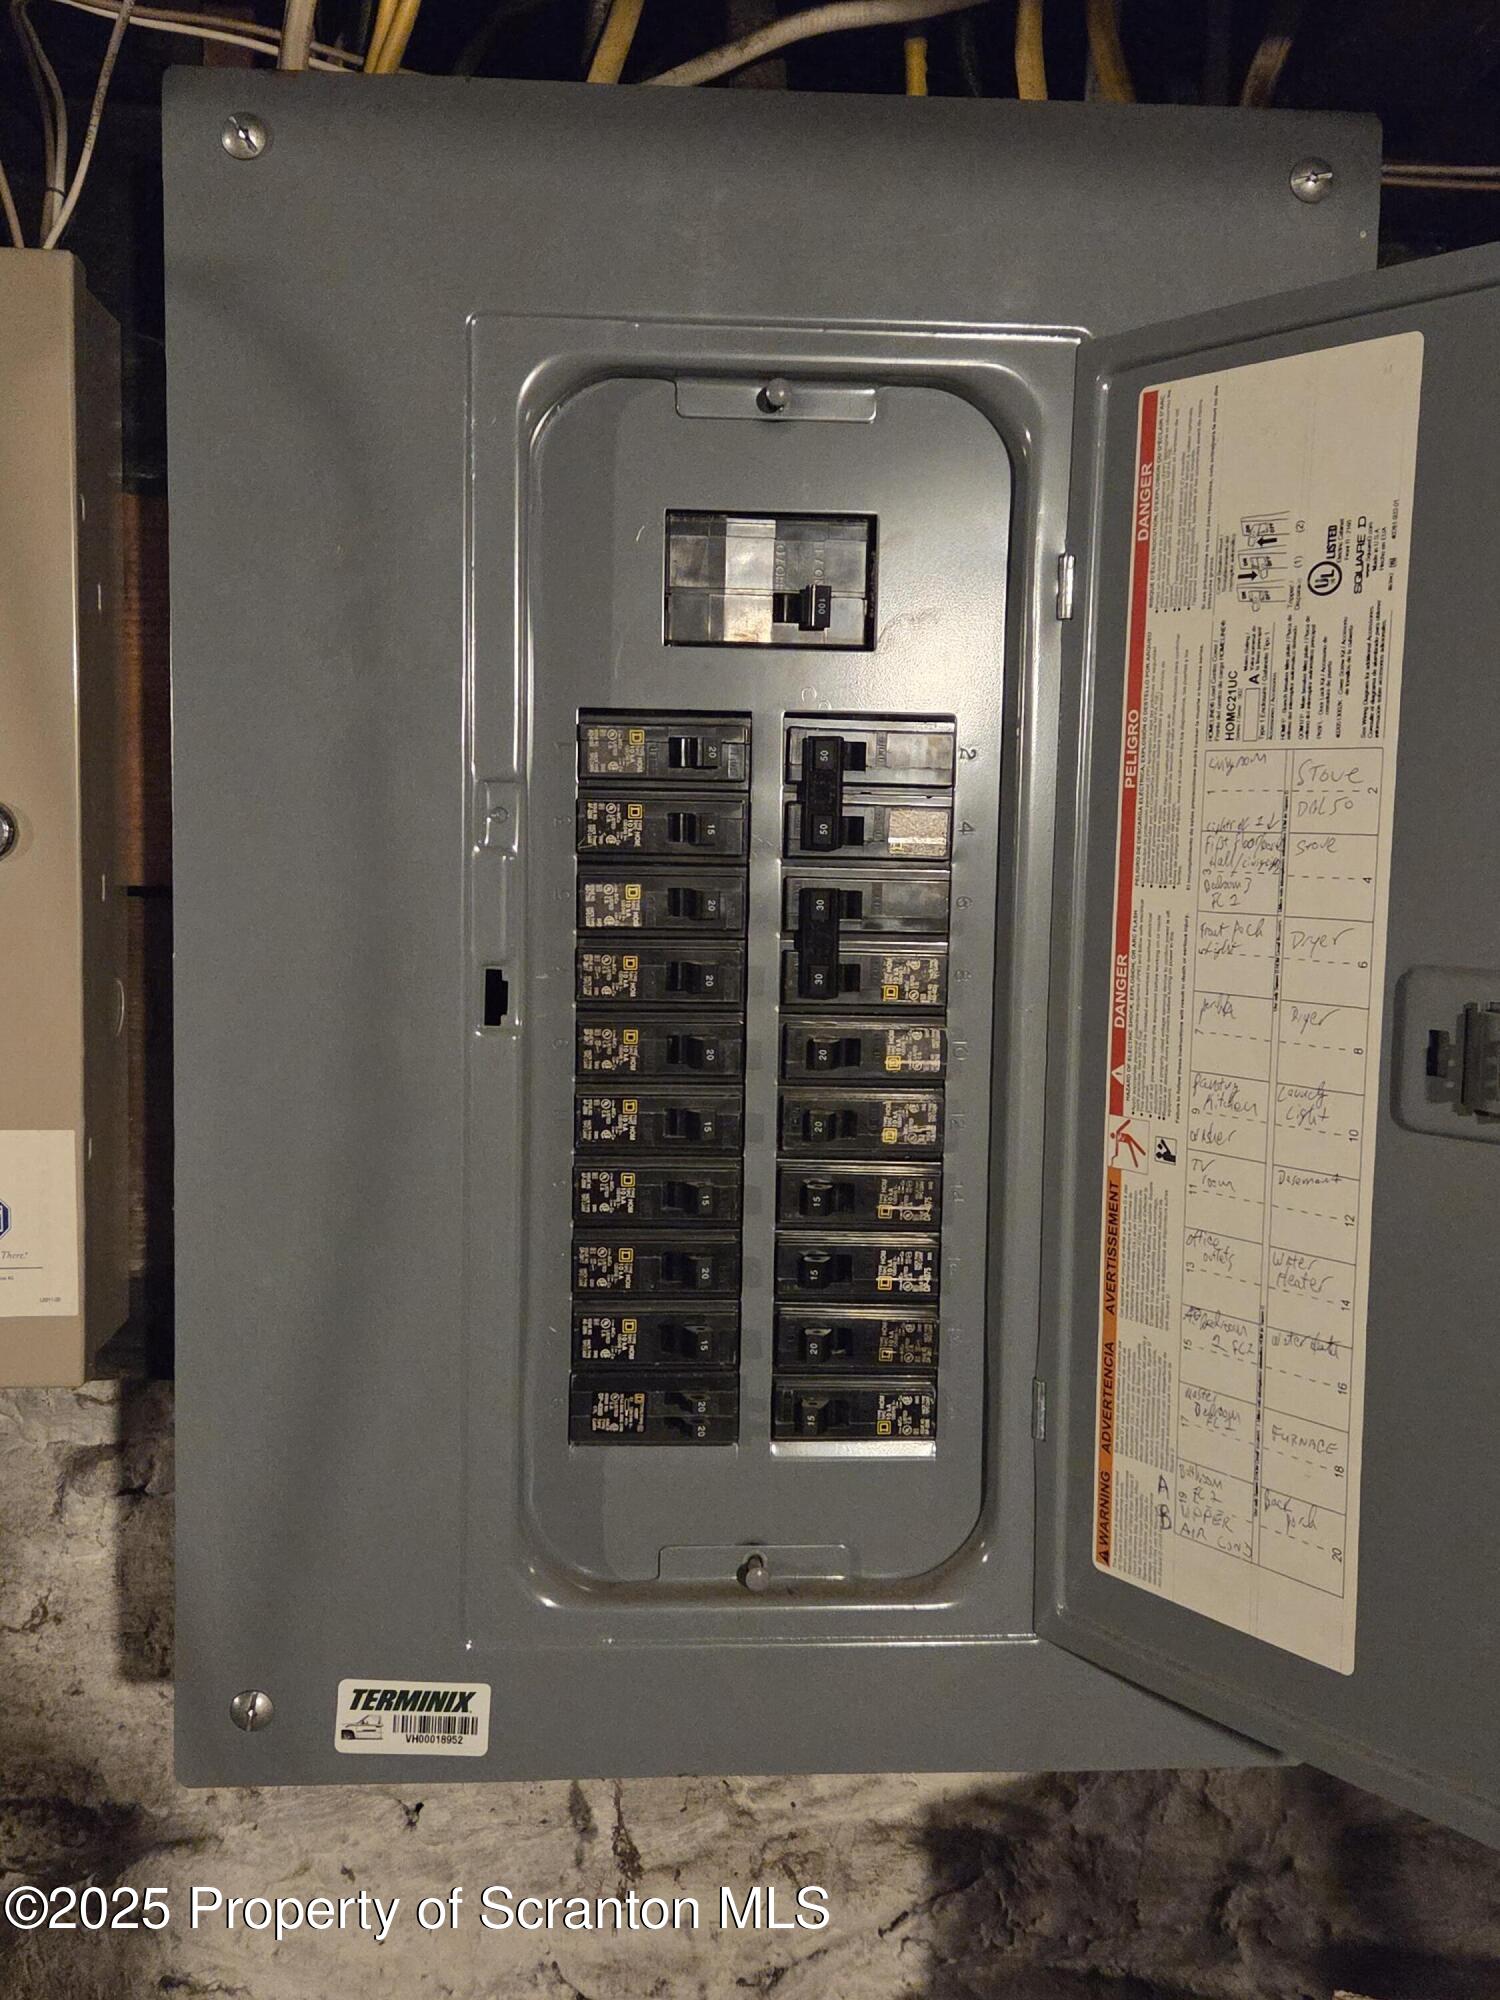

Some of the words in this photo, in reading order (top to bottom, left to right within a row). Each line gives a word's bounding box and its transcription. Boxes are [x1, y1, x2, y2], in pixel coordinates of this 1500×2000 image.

[1137, 461, 1154, 541] DANGER
[1295, 519, 1306, 533] (2)
[1358, 515, 1367, 528] D
[1326, 524, 1338, 559] LISTED
[1293, 555, 1303, 568] (1)
[1354, 533, 1366, 594] SQUARE
[817, 598, 826, 615] 100
[1249, 673, 1260, 684] A
[1225, 670, 1239, 741] HOMC21UC
[708, 746, 717, 759] 20
[959, 747, 977, 761] 2
[1124, 708, 1140, 788] PELIGRO
[820, 750, 829, 762] 50
[707, 824, 715, 836] 15
[819, 823, 828, 835] 50
[958, 821, 975, 834] 4
[1202, 868, 1212, 876] 3
[1363, 877, 1372, 885] 4
[708, 899, 716, 912] 20
[816, 899, 825, 911] 30
[1358, 961, 1368, 969] 6
[705, 975, 714, 987] 20
[814, 973, 823, 985] 30
[1114, 952, 1129, 1028] DANGER
[706, 1049, 714, 1061] 20
[819, 1049, 827, 1061] 20
[1353, 1048, 1363, 1056] 8
[1191, 1107, 1200, 1115] 9
[704, 1121, 712, 1133] 15
[814, 1121, 823, 1133] 20
[1349, 1129, 1359, 1142] 10
[1188, 1183, 1197, 1195] 11
[702, 1195, 710, 1206] 15
[813, 1196, 821, 1207] 15
[1344, 1214, 1355, 1227] 12
[1105, 1179, 1120, 1315] AVERTISSEMENT
[1186, 1262, 1195, 1272] 13
[701, 1267, 710, 1280] 20
[810, 1269, 818, 1280] 15
[1340, 1300, 1351, 1311] 14
[700, 1340, 708, 1351] 15
[810, 1343, 818, 1355] 20
[1183, 1339, 1192, 1351] 15
[1337, 1383, 1348, 1395] 16
[1101, 1340, 1115, 1454] ADVERTENCIA
[698, 1401, 706, 1413] 20
[807, 1415, 815, 1426] 15
[698, 1426, 706, 1438] 20
[1334, 1465, 1344, 1478] 18
[1158, 1474, 1169, 1500] A
[1179, 1491, 1187, 1503] 19
[1099, 1470, 1112, 1546] WARNING
[1157, 1504, 1172, 1530] B
[1332, 1548, 1342, 1562] 20
[350, 1688, 476, 1713] TERMINIX
[406, 1734, 463, 1745] VH00018952
